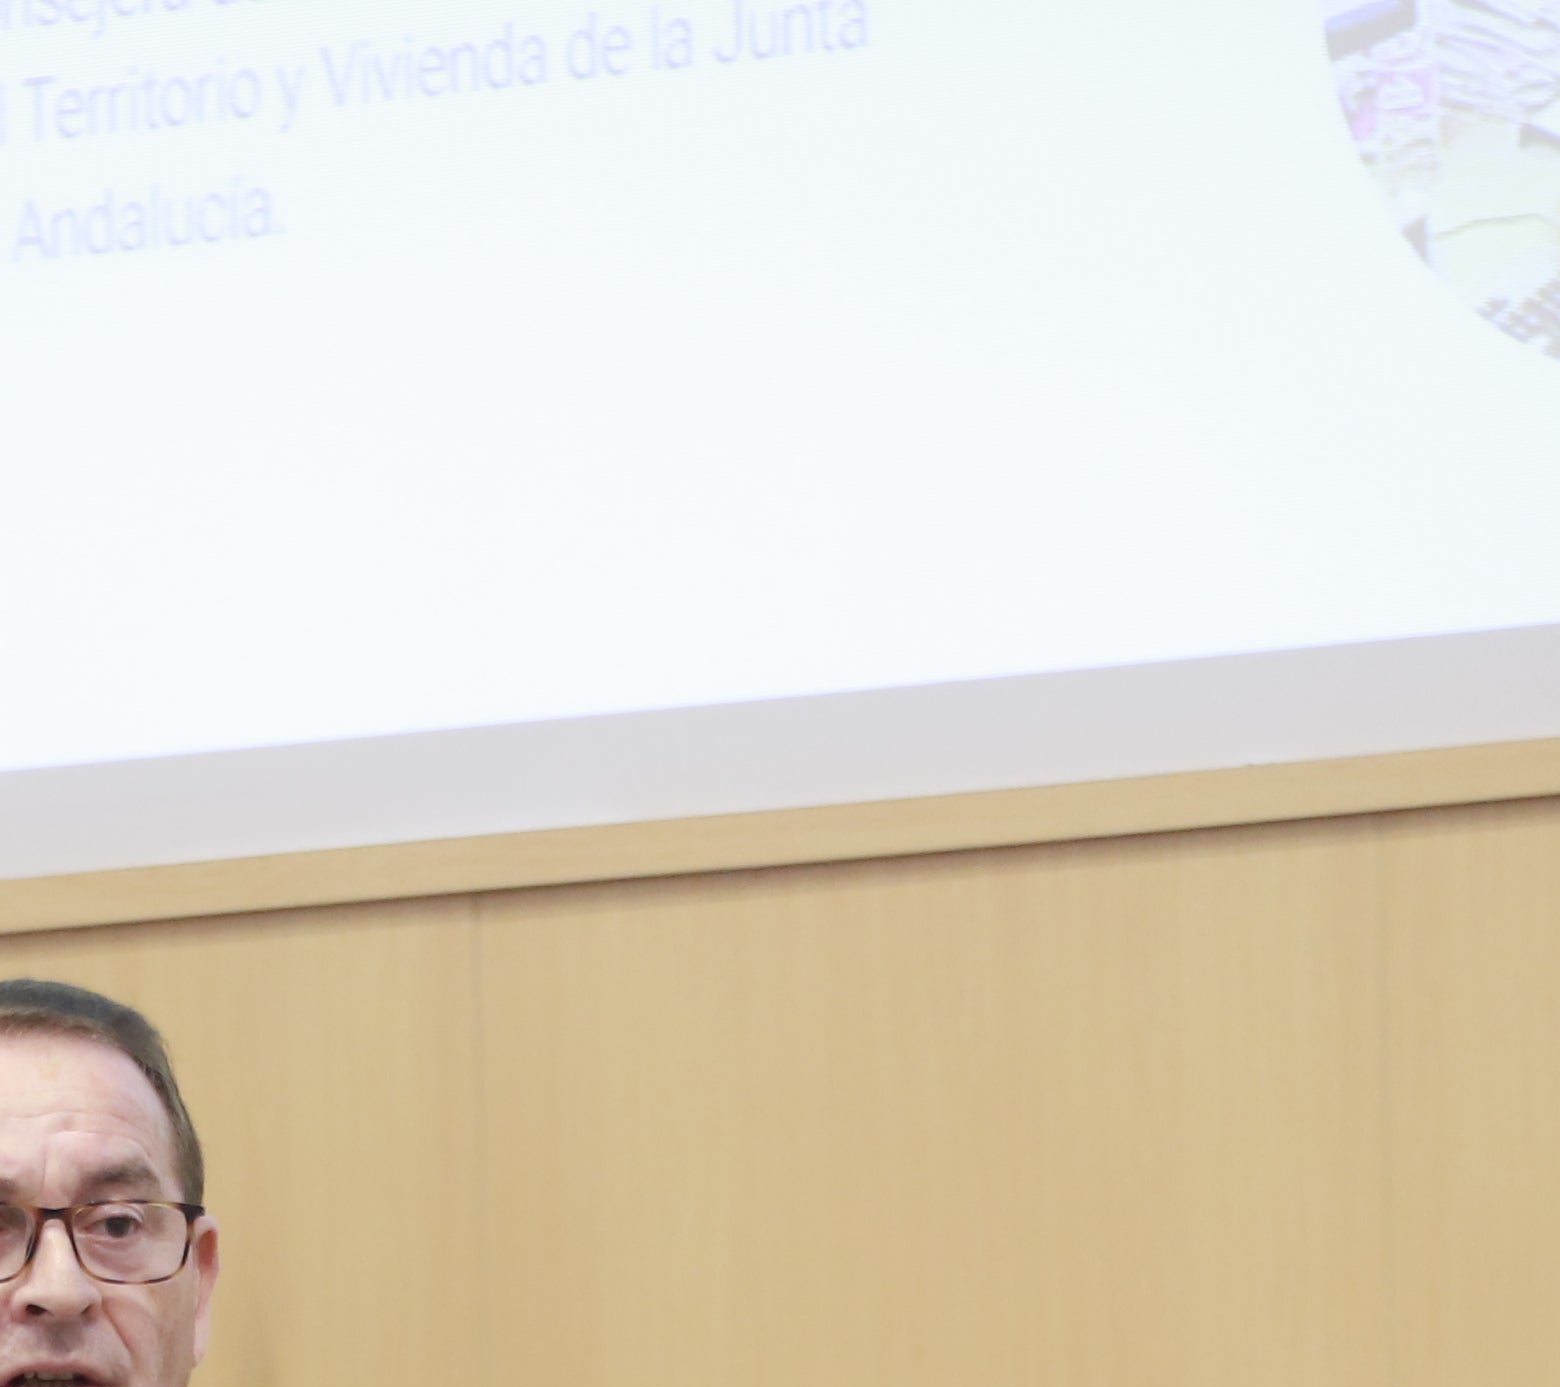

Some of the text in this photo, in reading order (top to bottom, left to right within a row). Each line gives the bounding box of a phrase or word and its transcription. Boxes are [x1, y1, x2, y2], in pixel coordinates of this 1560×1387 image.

[22, 58, 262, 142] Territorio
[274, 65, 307, 135] y
[320, 20, 549, 107] Vivienda
[565, 11, 634, 82] de
[649, 5, 694, 71] la
[712, 0, 870, 65] Junta
